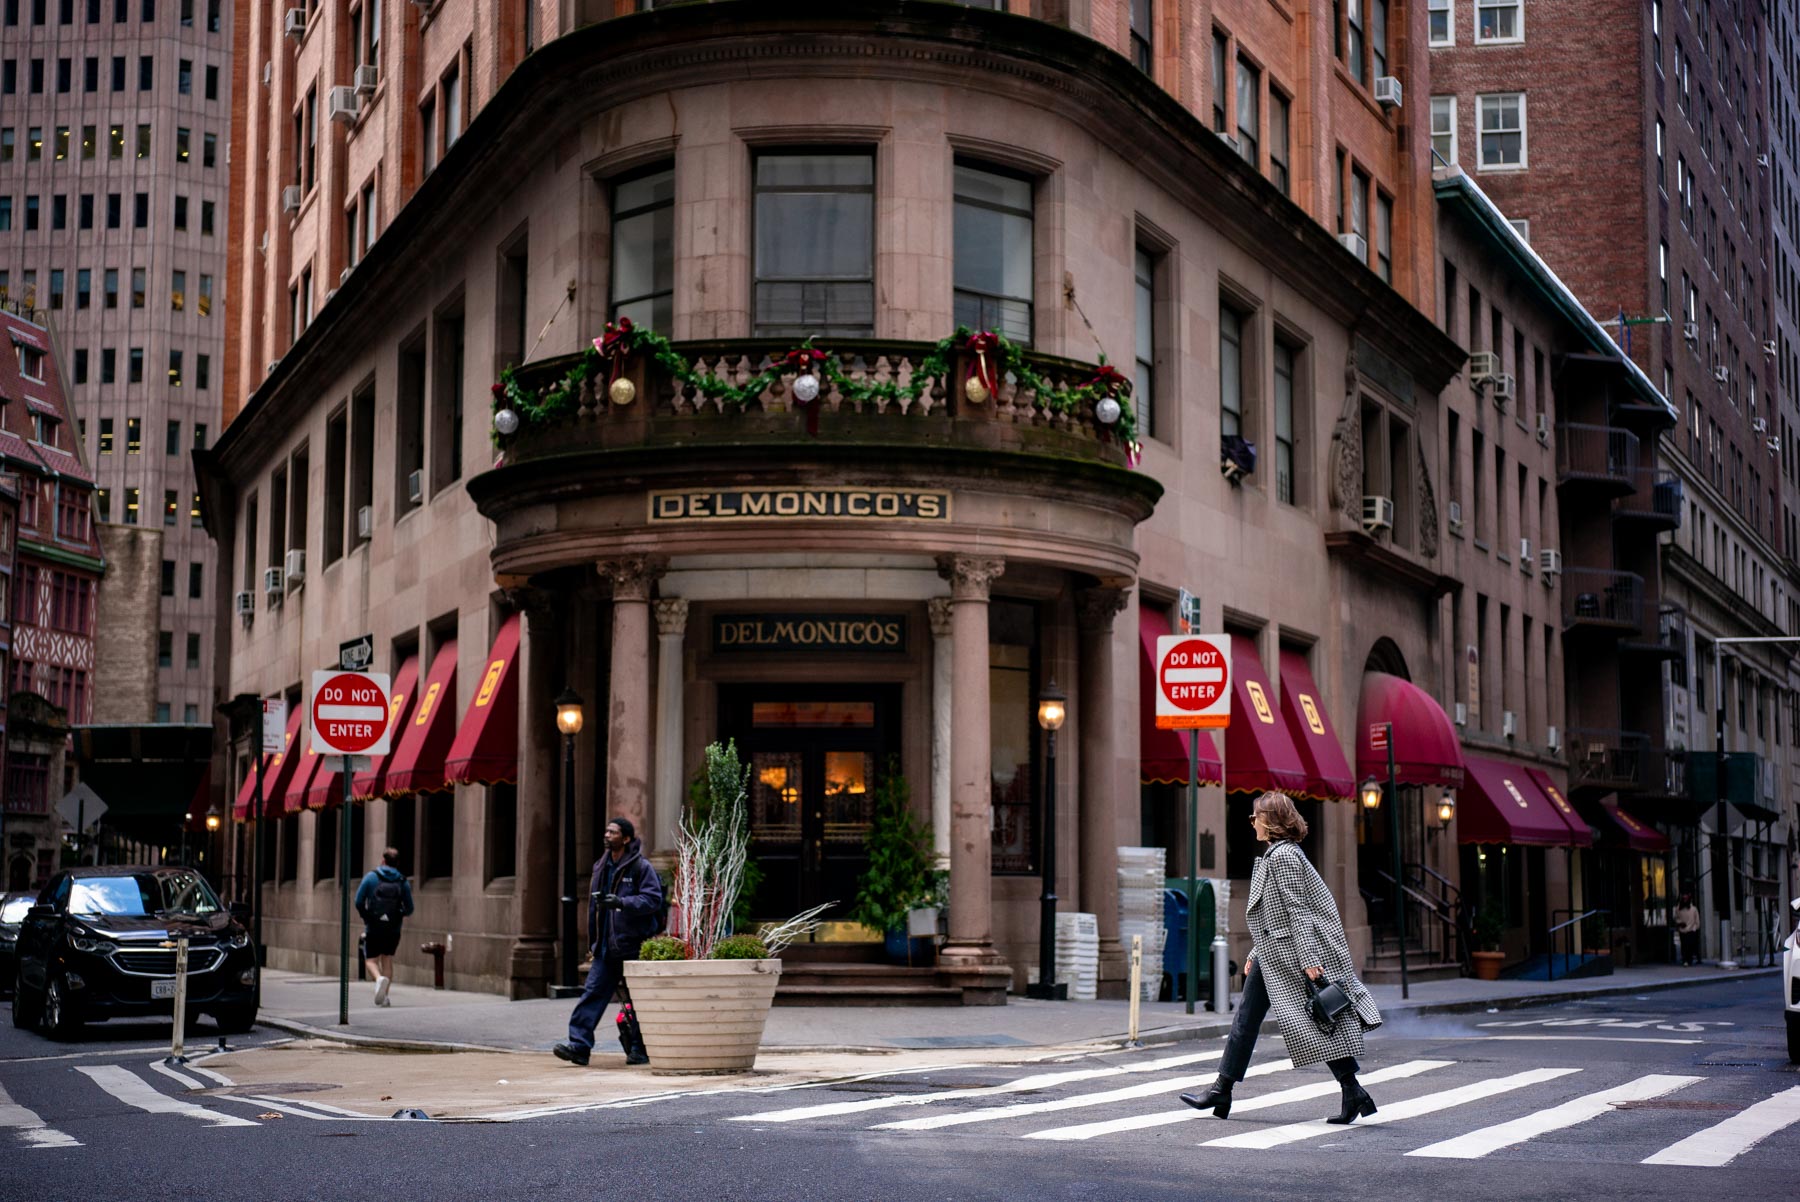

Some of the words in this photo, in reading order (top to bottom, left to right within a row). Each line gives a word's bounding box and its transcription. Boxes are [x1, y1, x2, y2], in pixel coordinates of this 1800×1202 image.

[658, 492, 941, 517] DELMONICO'S
[344, 649, 354, 661] ONE
[358, 645, 368, 658] WAY
[1170, 652, 1188, 665] DO
[1193, 651, 1217, 665] NOT
[324, 687, 343, 701] DO
[351, 689, 377, 702] NOT
[1171, 685, 1215, 699] ENTER
[329, 723, 372, 737] ENTER
